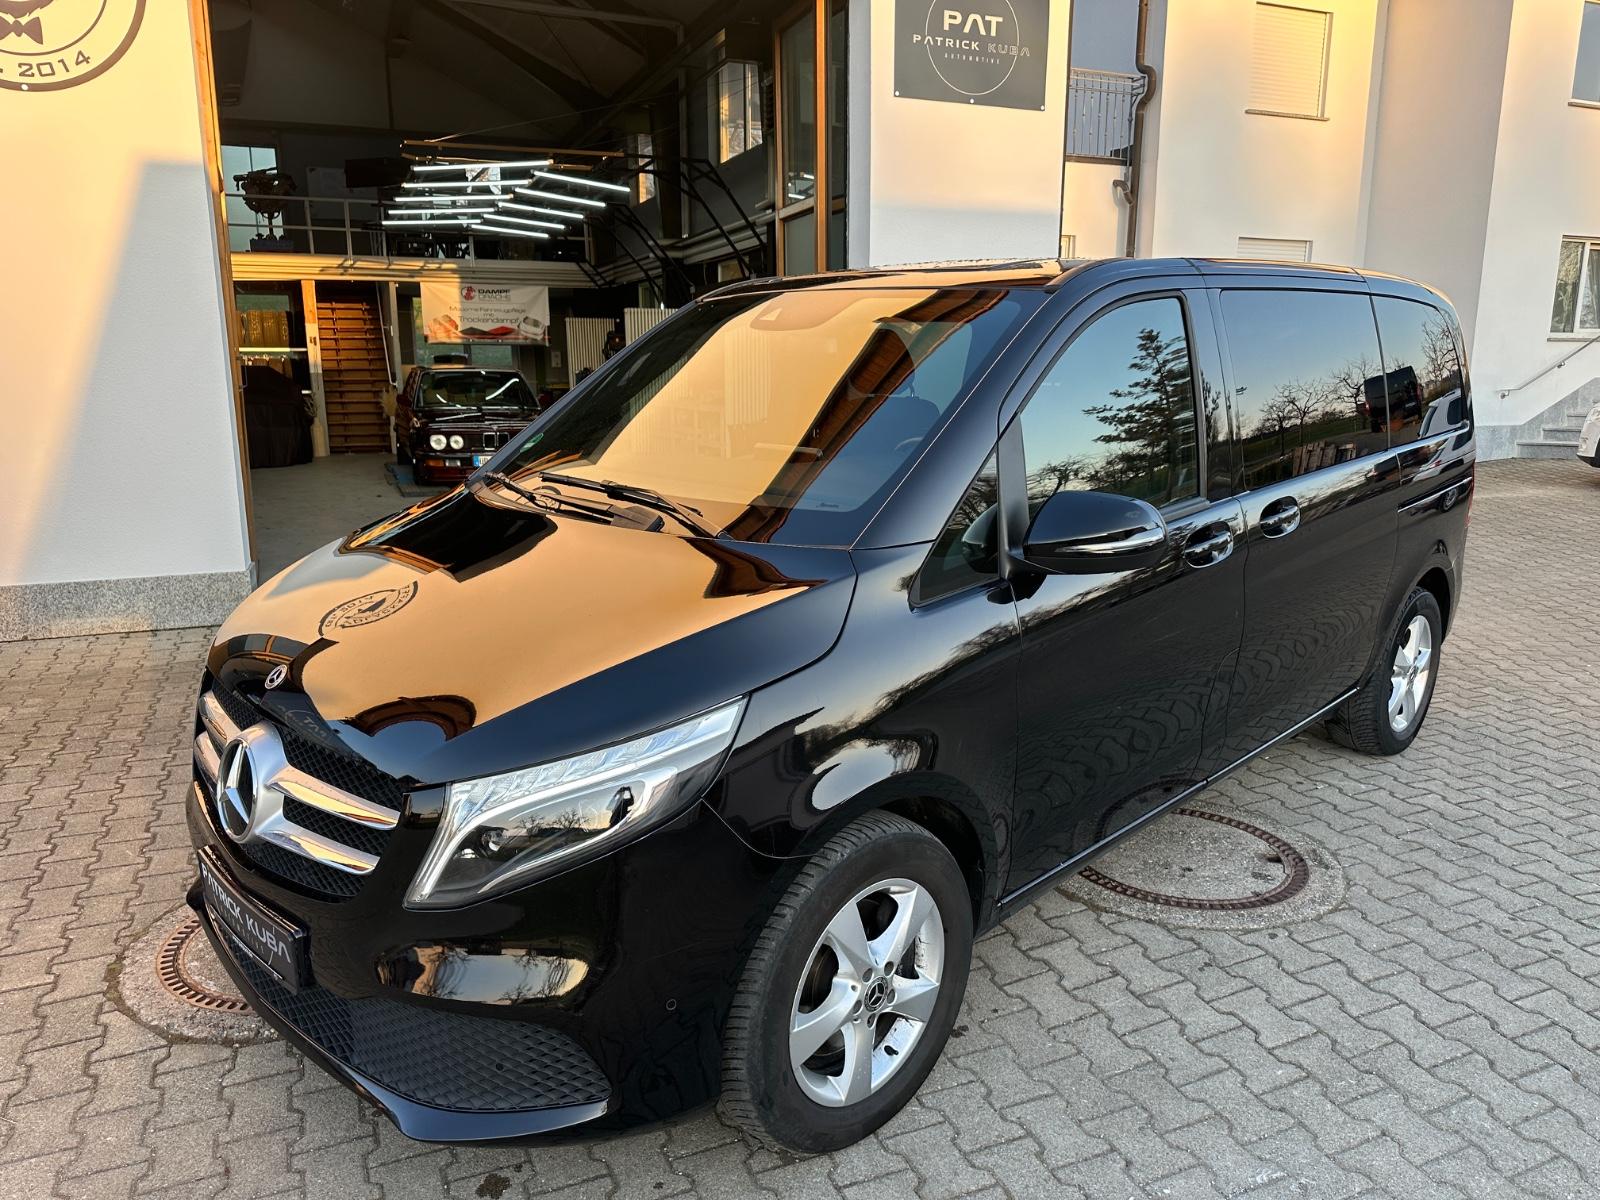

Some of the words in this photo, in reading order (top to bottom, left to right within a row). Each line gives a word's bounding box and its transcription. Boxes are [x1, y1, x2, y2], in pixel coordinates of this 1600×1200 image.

[943, 9, 1003, 37] PAT
[912, 33, 980, 51] PATRICK
[987, 42, 1031, 57] KUBA
[944, 52, 1000, 65] AUTOMOTIVE
[17, 50, 91, 78] 2014
[201, 862, 244, 925] PATRICK
[245, 913, 292, 964] KUBA
